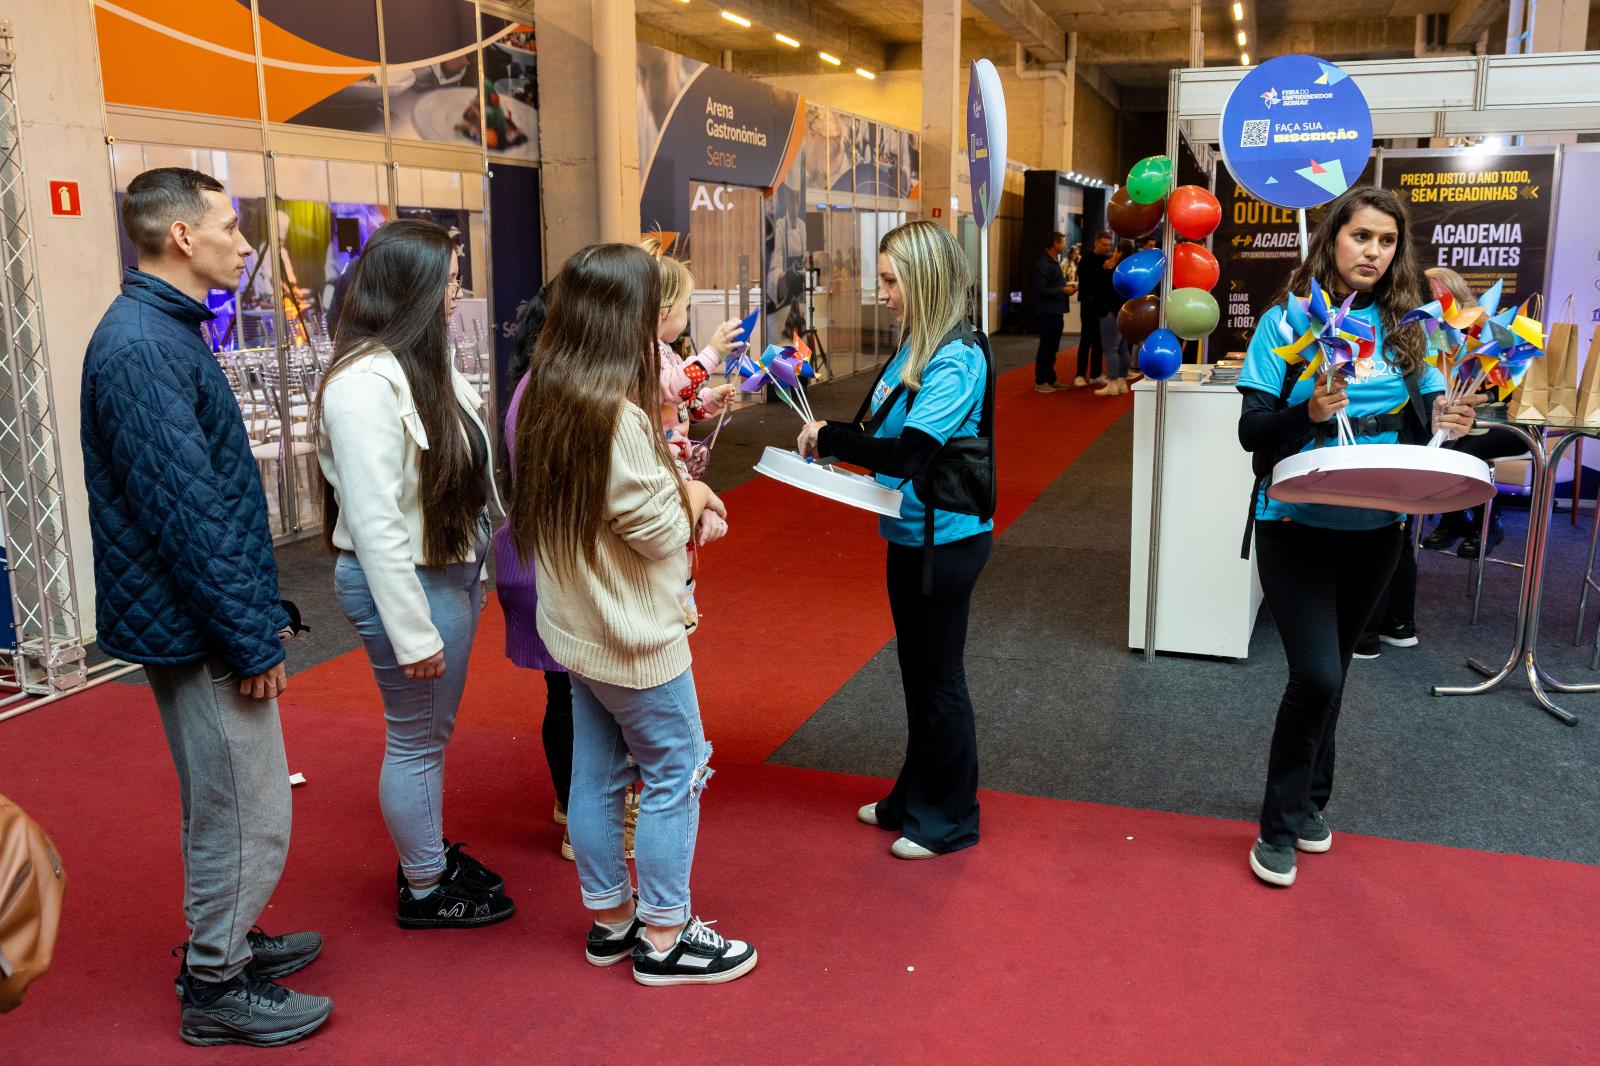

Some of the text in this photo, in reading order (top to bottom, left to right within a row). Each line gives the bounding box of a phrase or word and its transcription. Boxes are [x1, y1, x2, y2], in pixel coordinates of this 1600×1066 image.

[1282, 93, 1333, 101] EMPREENDEDOR
[706, 97, 734, 120] Arena
[706, 118, 767, 147] Gastronômica
[1275, 121, 1323, 134] FAÇA SUA
[1274, 128, 1359, 144] INSCRIÇÃO
[707, 146, 737, 169] Senac
[1400, 170, 1531, 187] PREÇO JUSTO O ANO TODO,
[1411, 186, 1518, 202] SEM PEGADINHAS
[1431, 223, 1523, 244] ACADEMIA
[1437, 246, 1521, 267] E PILATES
[1229, 293, 1249, 302] LOJAS
[1228, 304, 1251, 315] 1086
[1227, 316, 1255, 328] E 1087
